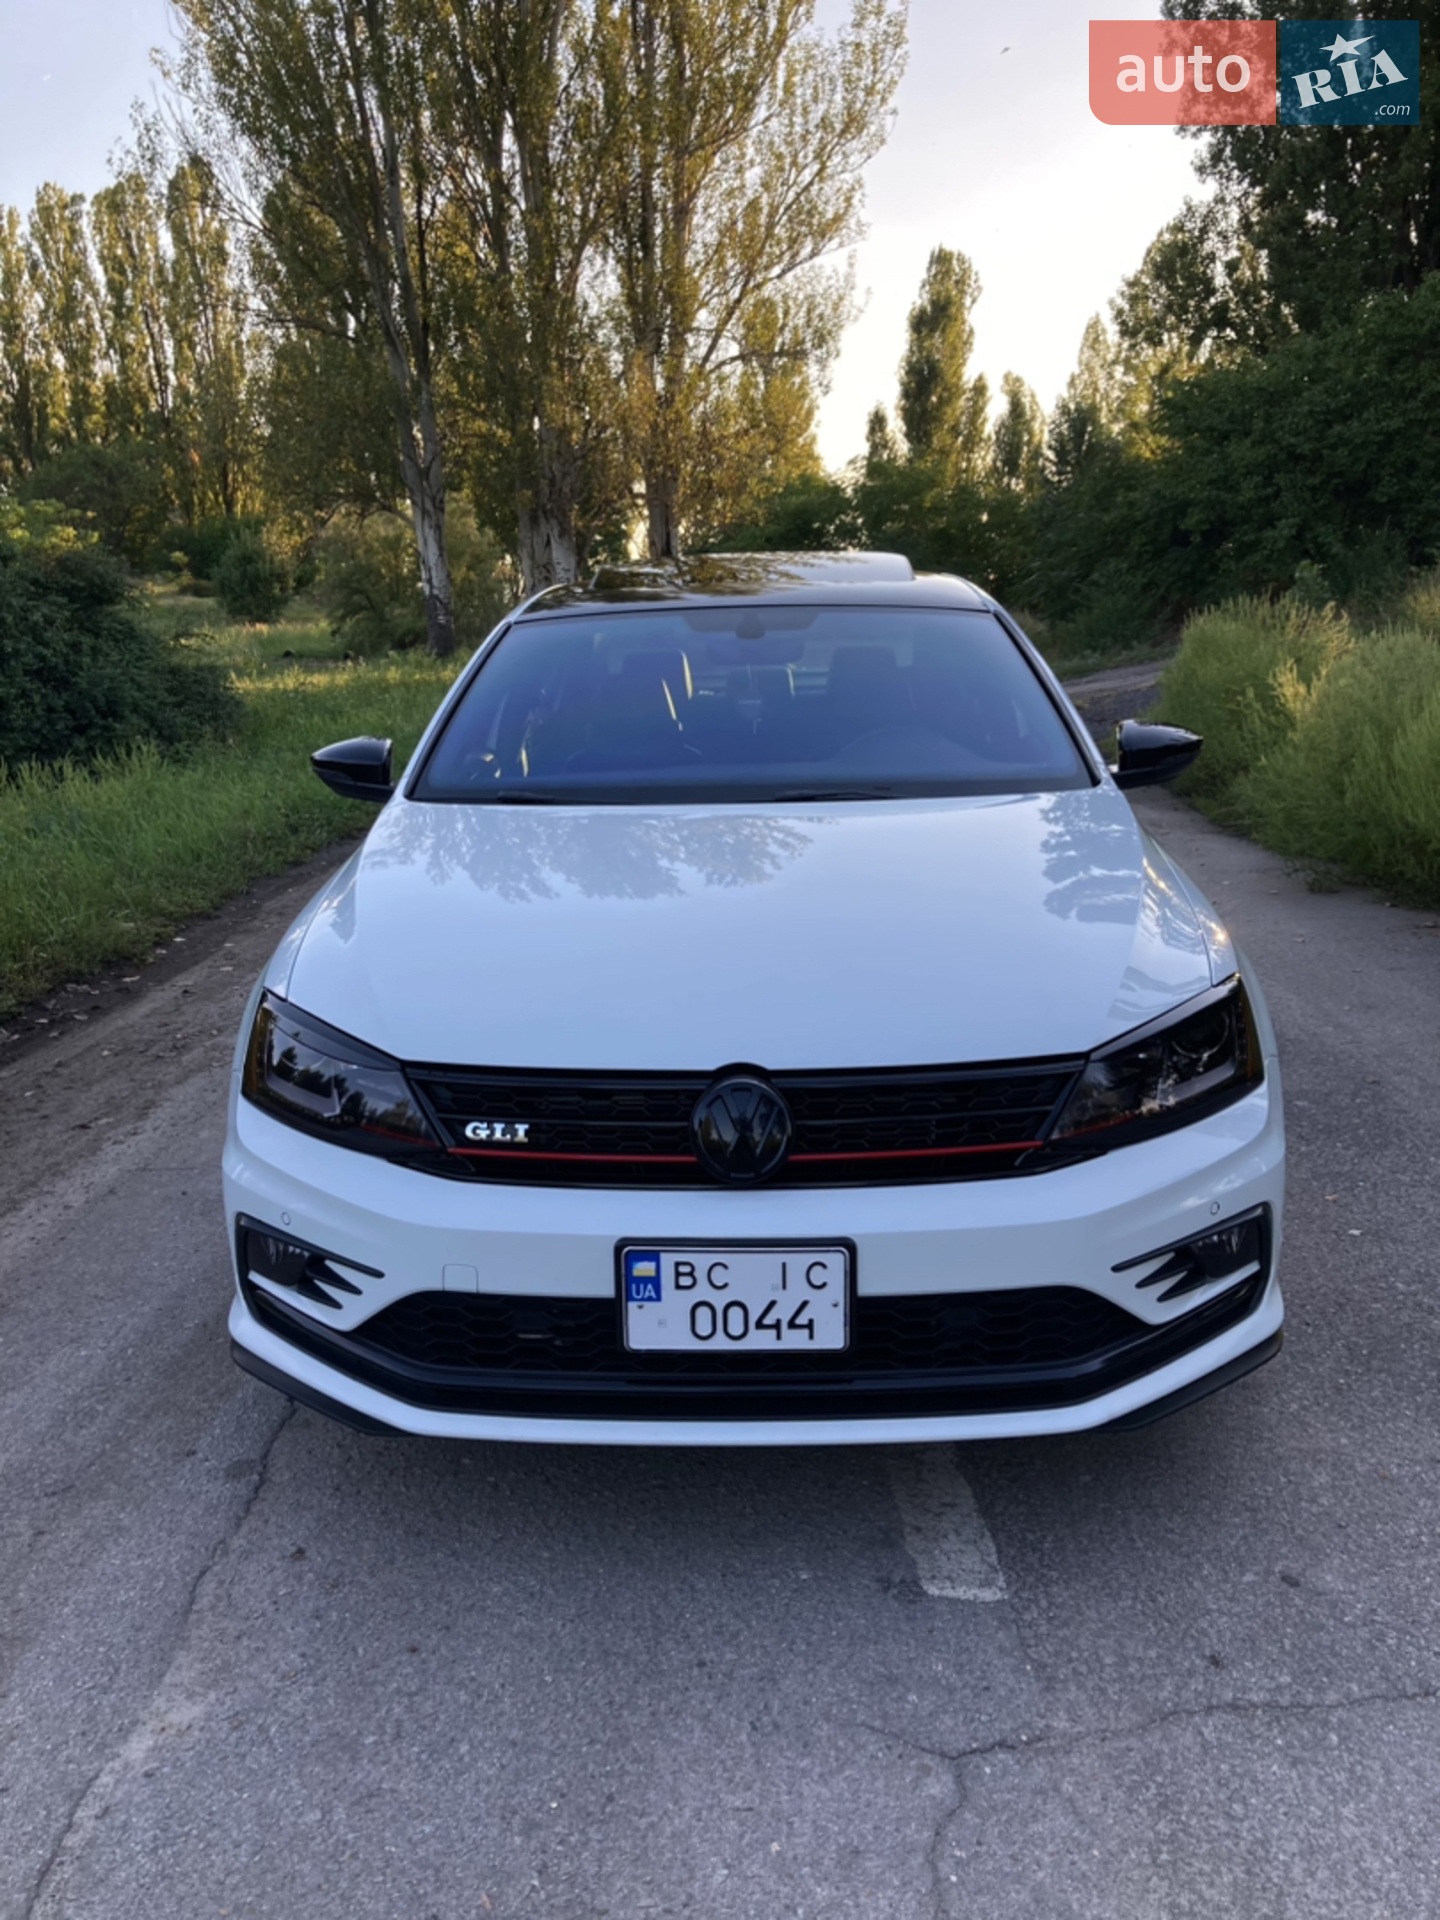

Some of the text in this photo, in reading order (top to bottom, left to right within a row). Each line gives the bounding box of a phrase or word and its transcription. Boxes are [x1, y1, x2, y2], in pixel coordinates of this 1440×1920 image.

[464, 1121, 529, 1143] GLI
[674, 1260, 729, 1290] BC
[631, 1283, 657, 1299] UA
[689, 1299, 814, 1341] 0044
